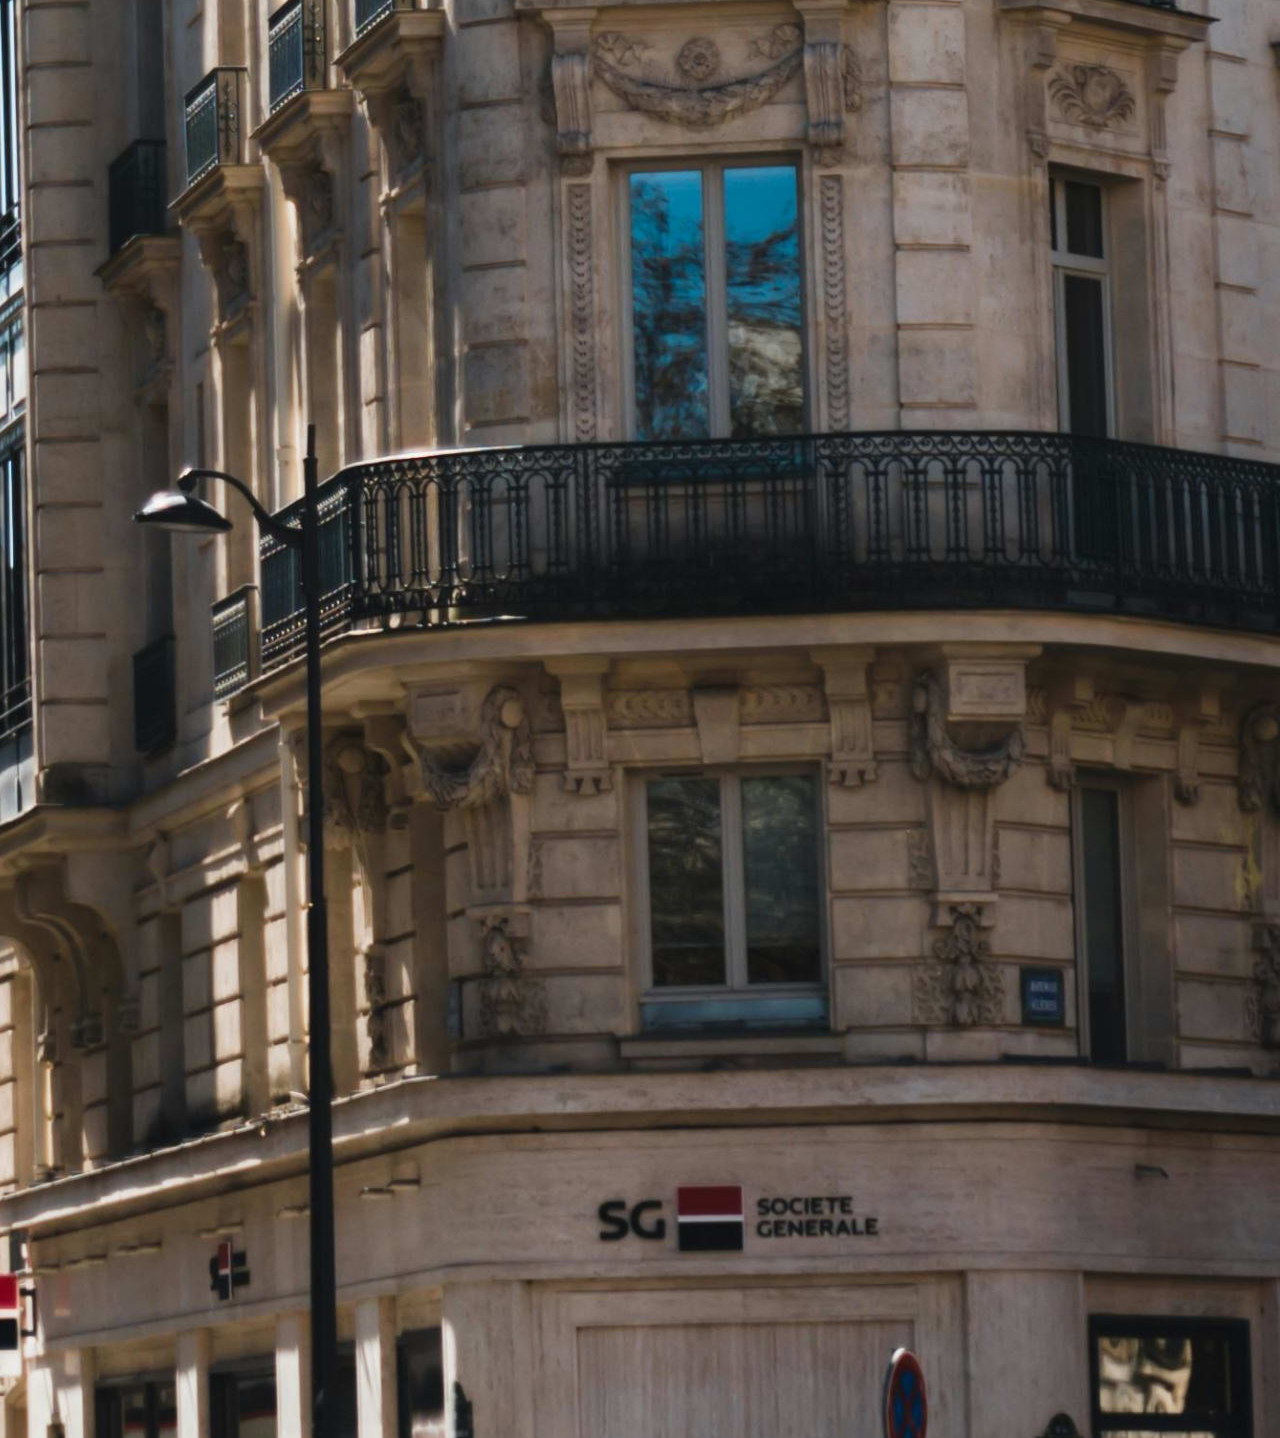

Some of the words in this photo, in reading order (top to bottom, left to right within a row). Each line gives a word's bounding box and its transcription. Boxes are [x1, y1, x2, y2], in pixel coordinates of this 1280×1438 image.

[756, 1196, 853, 1216] SOCIETE
[597, 1199, 666, 1241] SG
[756, 1218, 879, 1238] GENERALE
